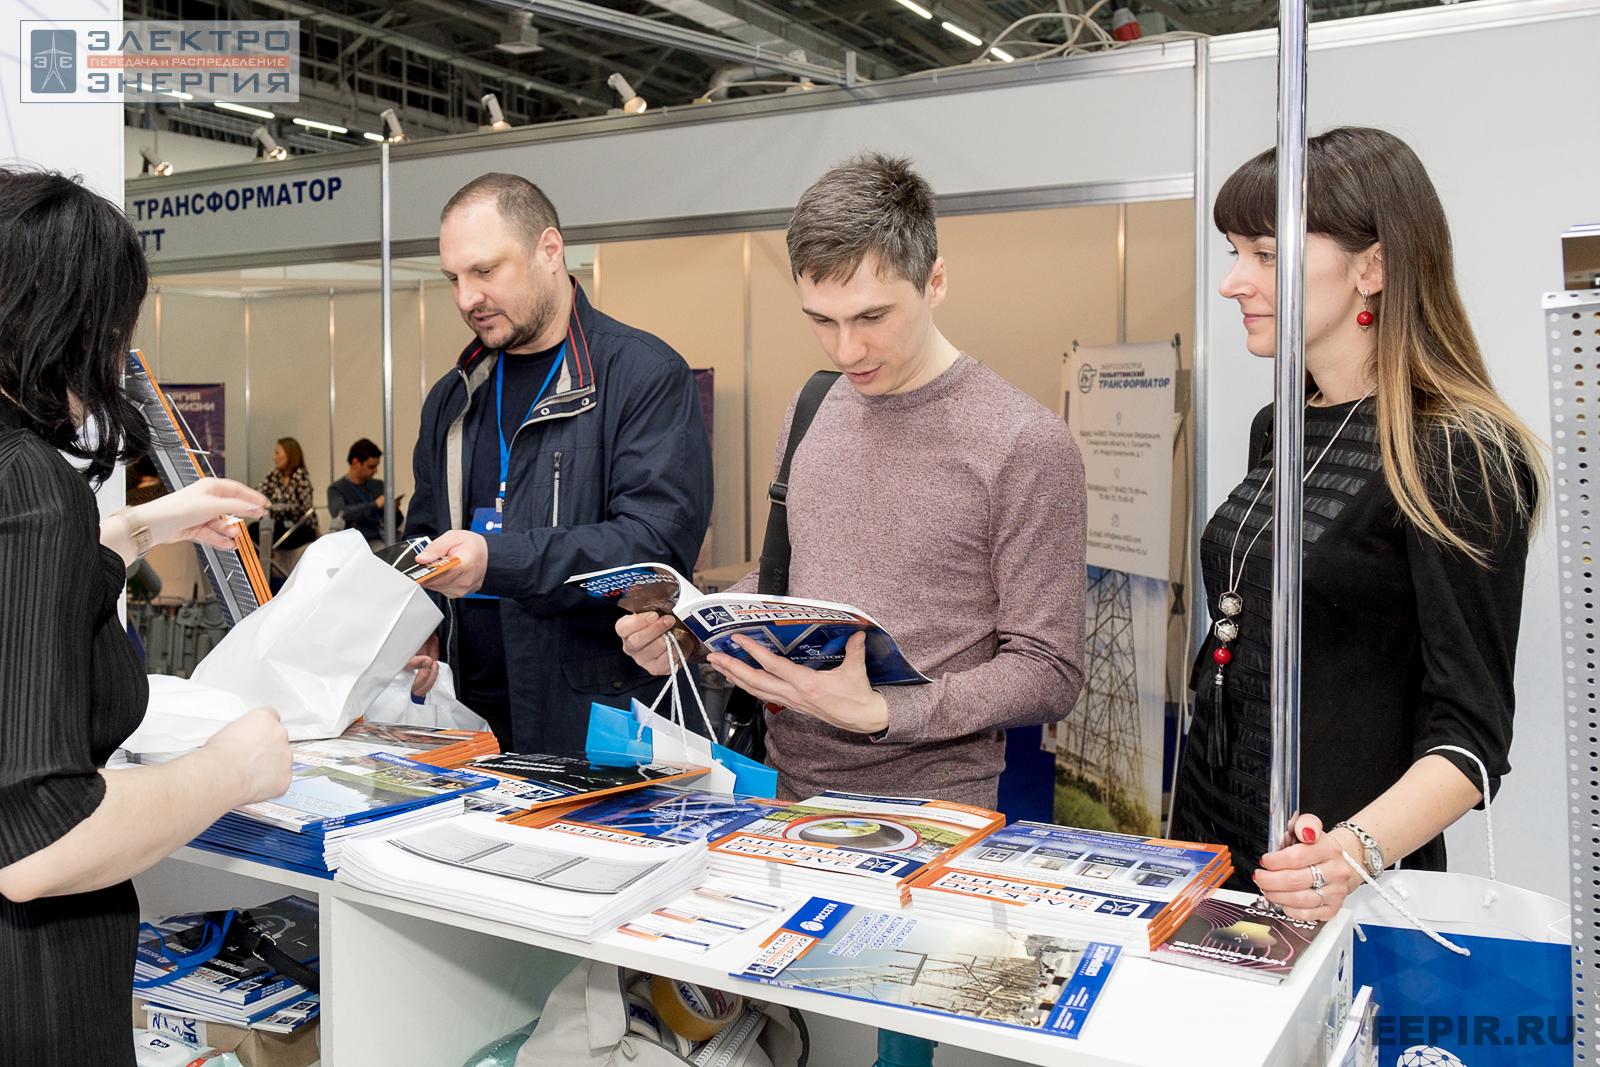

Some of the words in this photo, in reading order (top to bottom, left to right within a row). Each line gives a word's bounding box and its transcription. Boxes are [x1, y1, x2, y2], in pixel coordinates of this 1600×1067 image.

[133, 177, 342, 221] ТРАНСФОРМАТОР
[1099, 377, 1171, 389] ТРАНСФОРМАТОР
[580, 571, 641, 588] СИСТЕМА
[726, 844, 852, 867] ЭЛЕКТРО
[738, 837, 863, 861] ЭНЕРГИЯ
[940, 881, 1088, 911] ЭЛЕКТРО
[951, 874, 1097, 900] ЭНЕРГИЯ
[756, 933, 793, 963] ЭЛЕКТРО
[773, 937, 810, 967] ЭНЕРГИЯ
